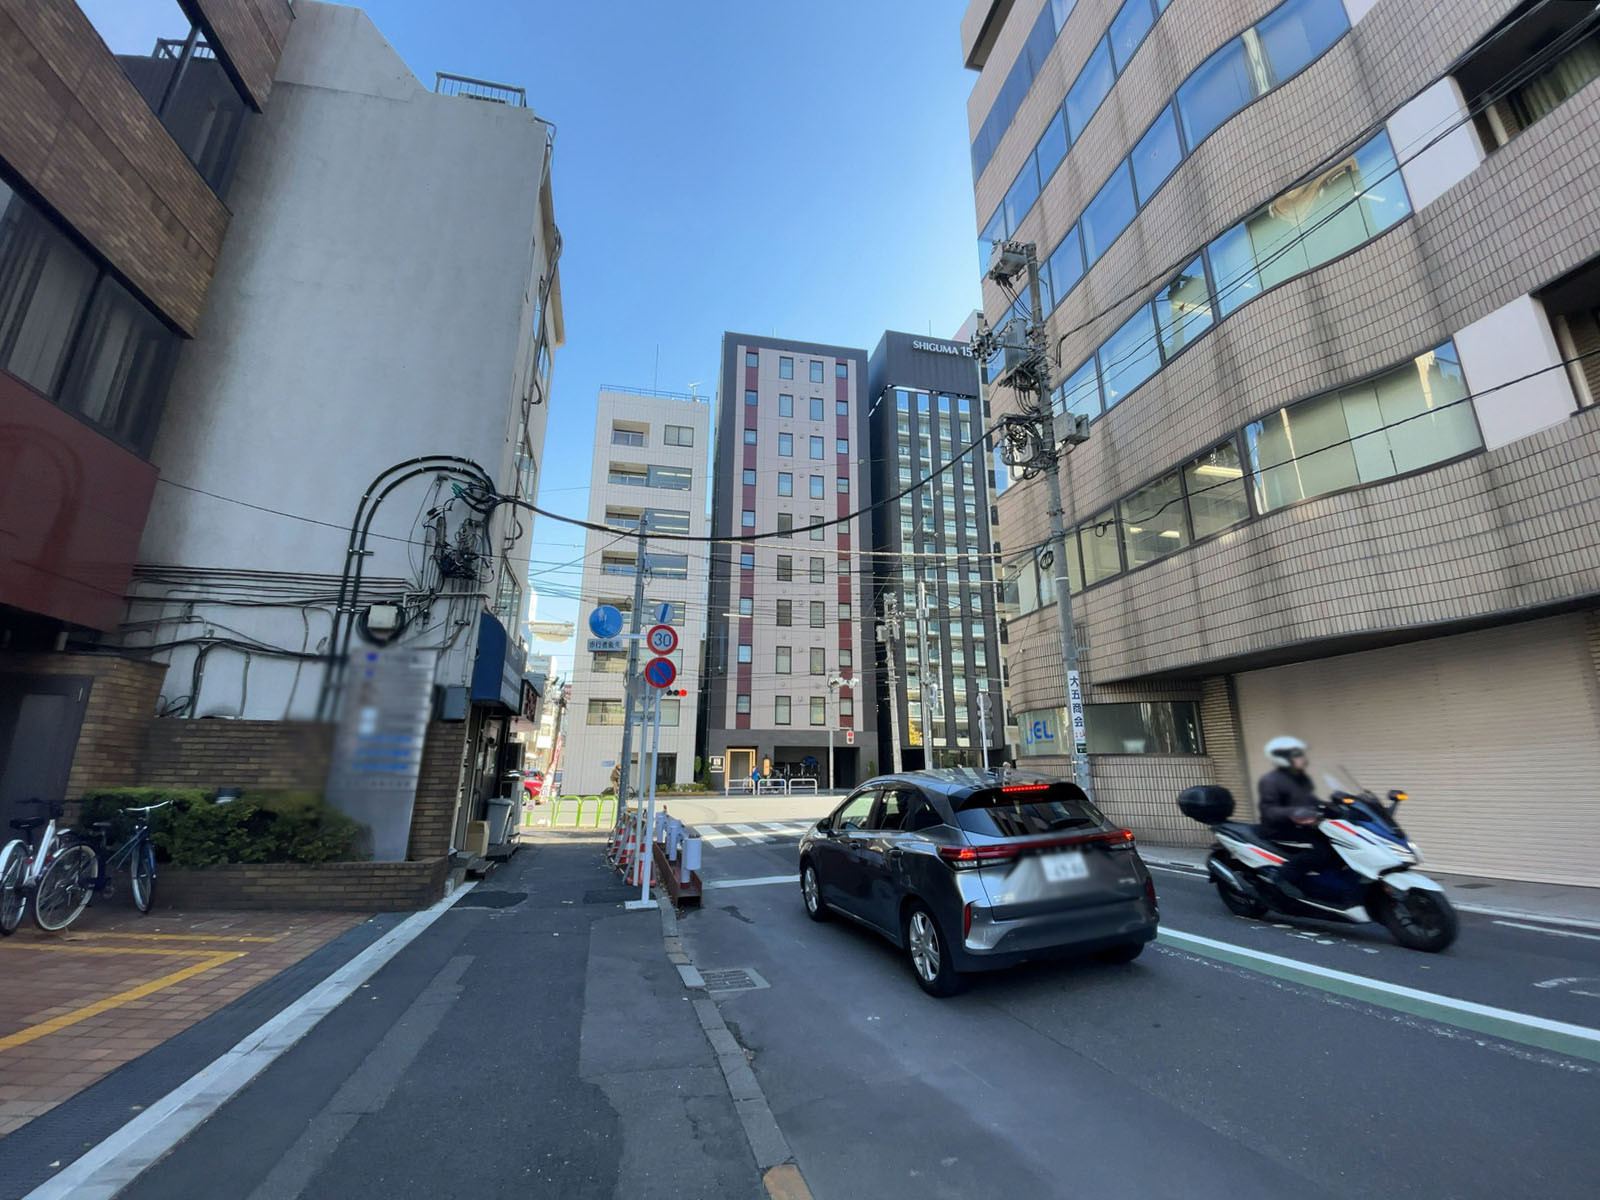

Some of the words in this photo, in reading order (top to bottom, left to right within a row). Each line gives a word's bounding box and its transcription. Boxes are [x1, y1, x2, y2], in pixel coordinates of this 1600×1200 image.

[913, 340, 959, 355] SHIGUMA
[654, 633, 672, 647] 30
[1069, 675, 1084, 727] 大五商会
